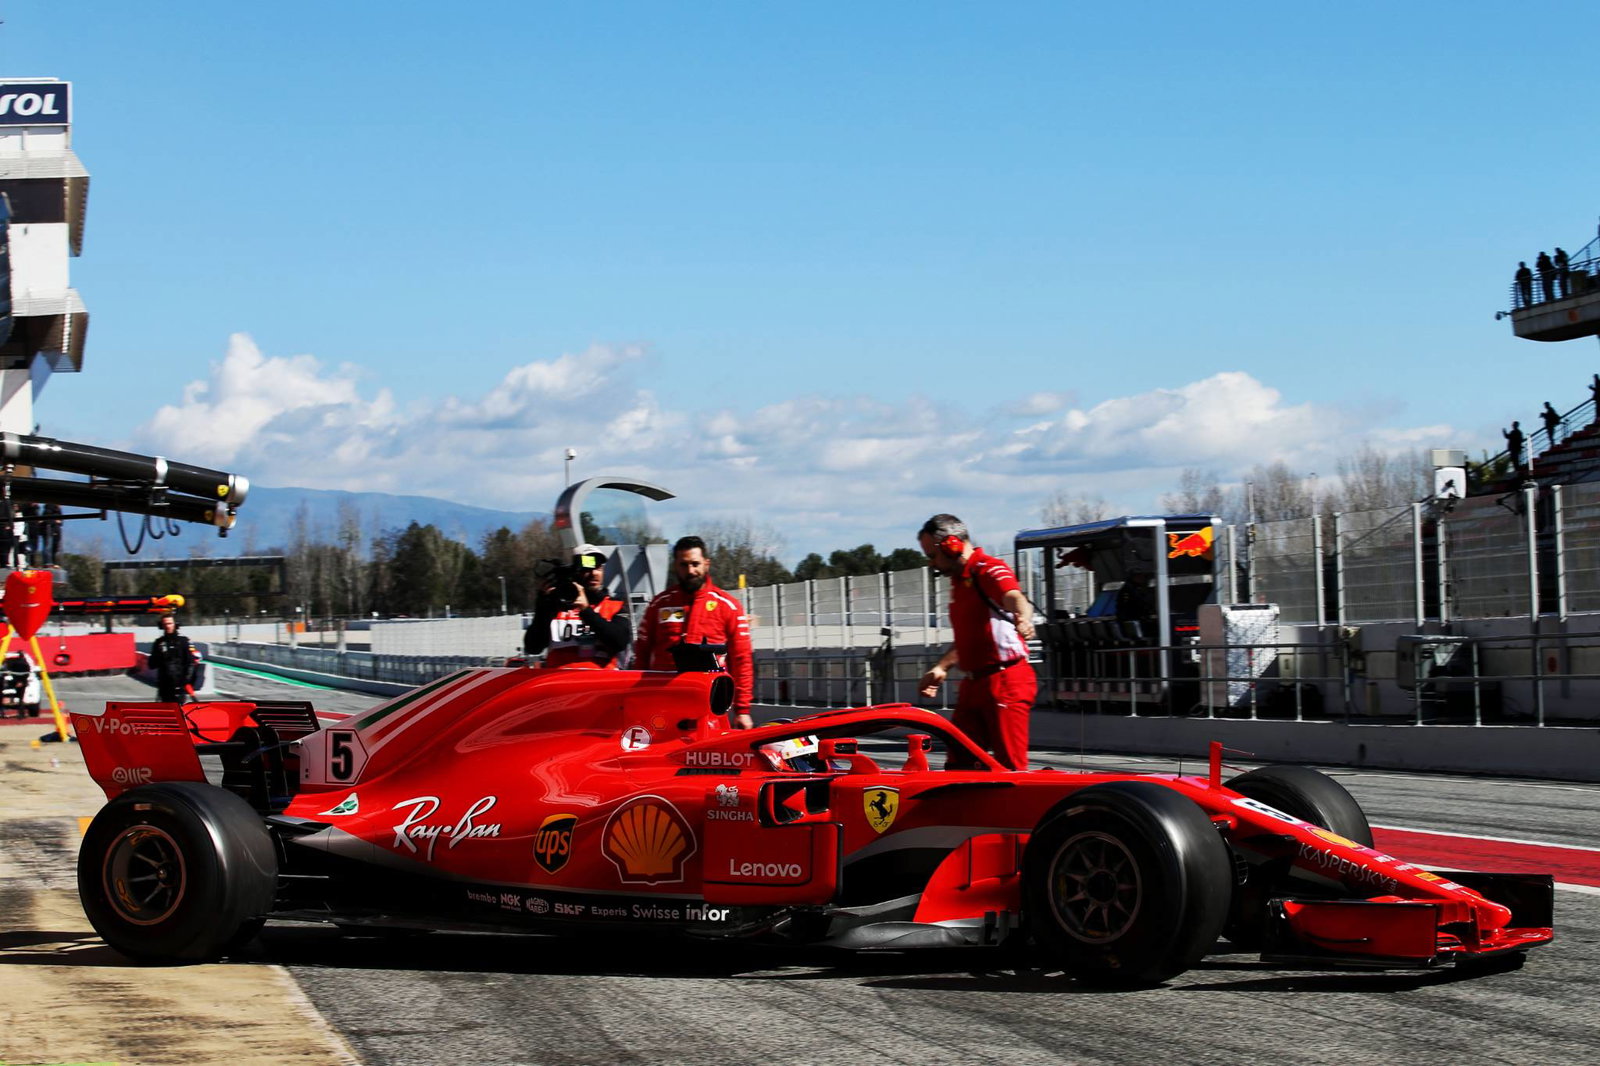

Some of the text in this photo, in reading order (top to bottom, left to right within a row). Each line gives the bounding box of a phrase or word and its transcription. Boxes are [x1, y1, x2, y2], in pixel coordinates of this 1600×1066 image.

[332, 732, 353, 780] 5
[685, 751, 755, 767] HUBLOT
[707, 809, 754, 821] SINGHA
[536, 830, 571, 865] ups
[729, 858, 802, 878] Lenovo
[1298, 842, 1390, 888] KASPERSKY
[467, 890, 497, 904] brembo
[500, 893, 521, 907] NGK
[554, 902, 585, 915] SKF
[591, 906, 628, 917] Experis
[632, 904, 680, 919] Swisse
[685, 904, 730, 921] infor
